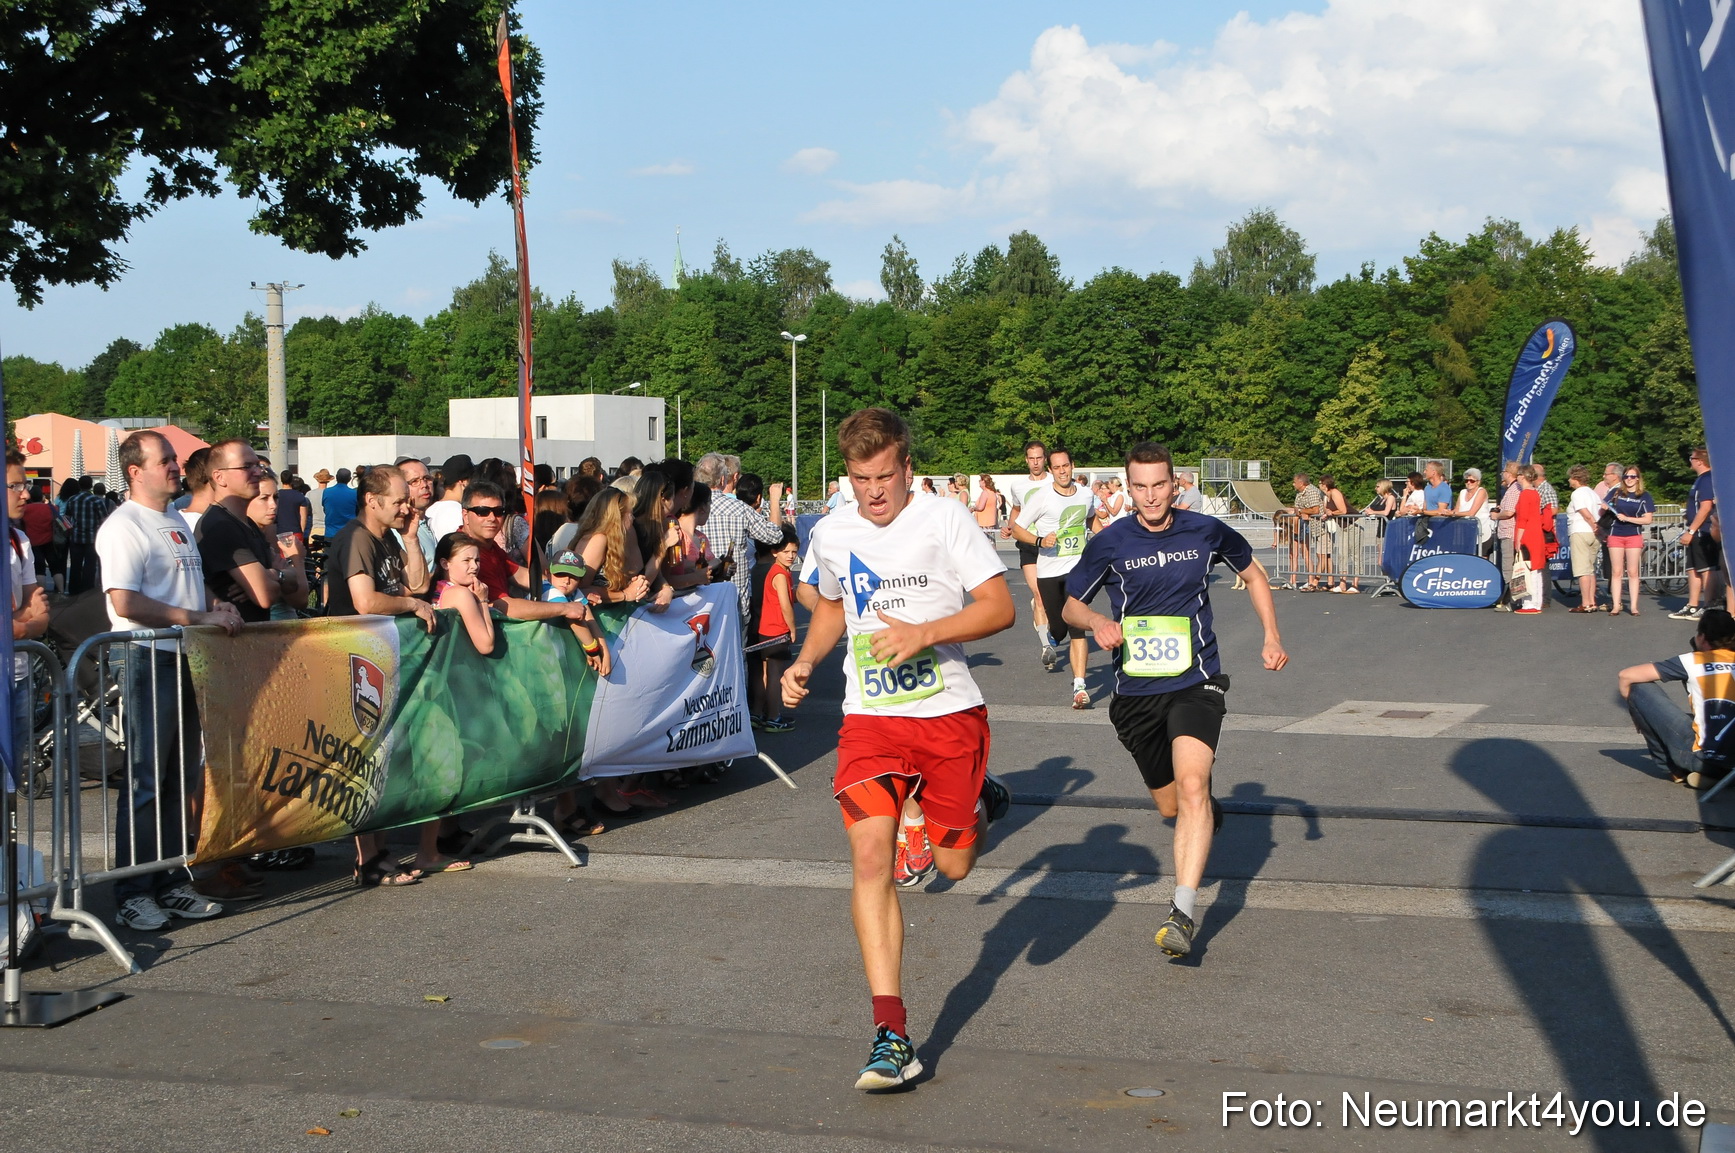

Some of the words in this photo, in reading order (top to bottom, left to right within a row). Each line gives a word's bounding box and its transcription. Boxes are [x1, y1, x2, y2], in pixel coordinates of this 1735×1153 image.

[1504, 359, 1553, 443] Frischmann
[1064, 536, 1079, 549] 92
[1124, 556, 1157, 571] EURO
[1166, 549, 1199, 563] POLES
[1426, 577, 1492, 590] Fischer
[1432, 589, 1487, 597] AUTOMOBILE
[864, 597, 906, 613] Team
[1132, 637, 1180, 661] 338
[864, 658, 937, 697] 5065
[682, 685, 733, 718] Neumarkter
[666, 705, 742, 753] Lammsbräu
